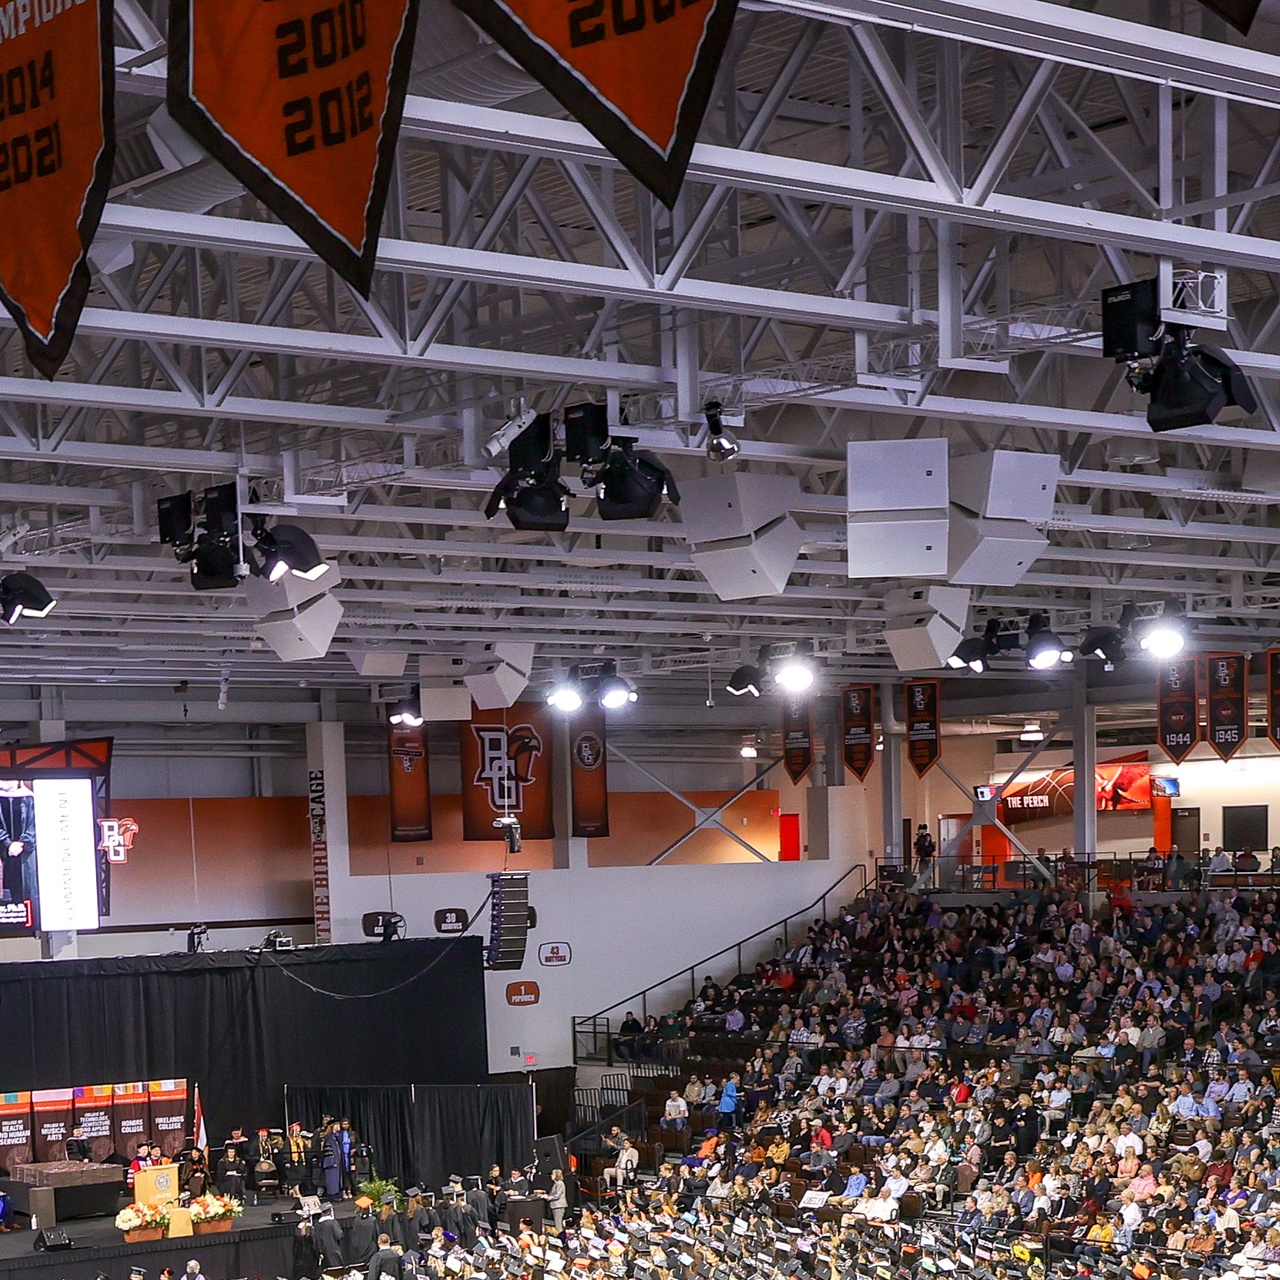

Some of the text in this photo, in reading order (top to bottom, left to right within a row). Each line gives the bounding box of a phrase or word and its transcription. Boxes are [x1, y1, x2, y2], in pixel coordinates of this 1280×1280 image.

[275, 0, 367, 79] 2010
[282, 70, 374, 157] 2012
[1166, 733, 1191, 745] 1944
[1215, 730, 1238, 742] 1945
[478, 731, 517, 806] BG
[1006, 795, 1049, 808] THE PERCH
[100, 821, 125, 861] BG
[309, 770, 331, 937] THE BIRD CAGE
[121, 1119, 144, 1127] HONORS
[155, 1115, 185, 1124] FIRELANDS
[2, 1124, 23, 1132] HEALTH
[121, 1125, 144, 1133] COLLEGE
[158, 1122, 182, 1130] COLLEGE
[9, 1130, 30, 1138] HUMAN
[41, 1127, 66, 1135] MUSICAL
[0, 1137, 27, 1146] SERVICES
[46, 1133, 63, 1141] ARTS
